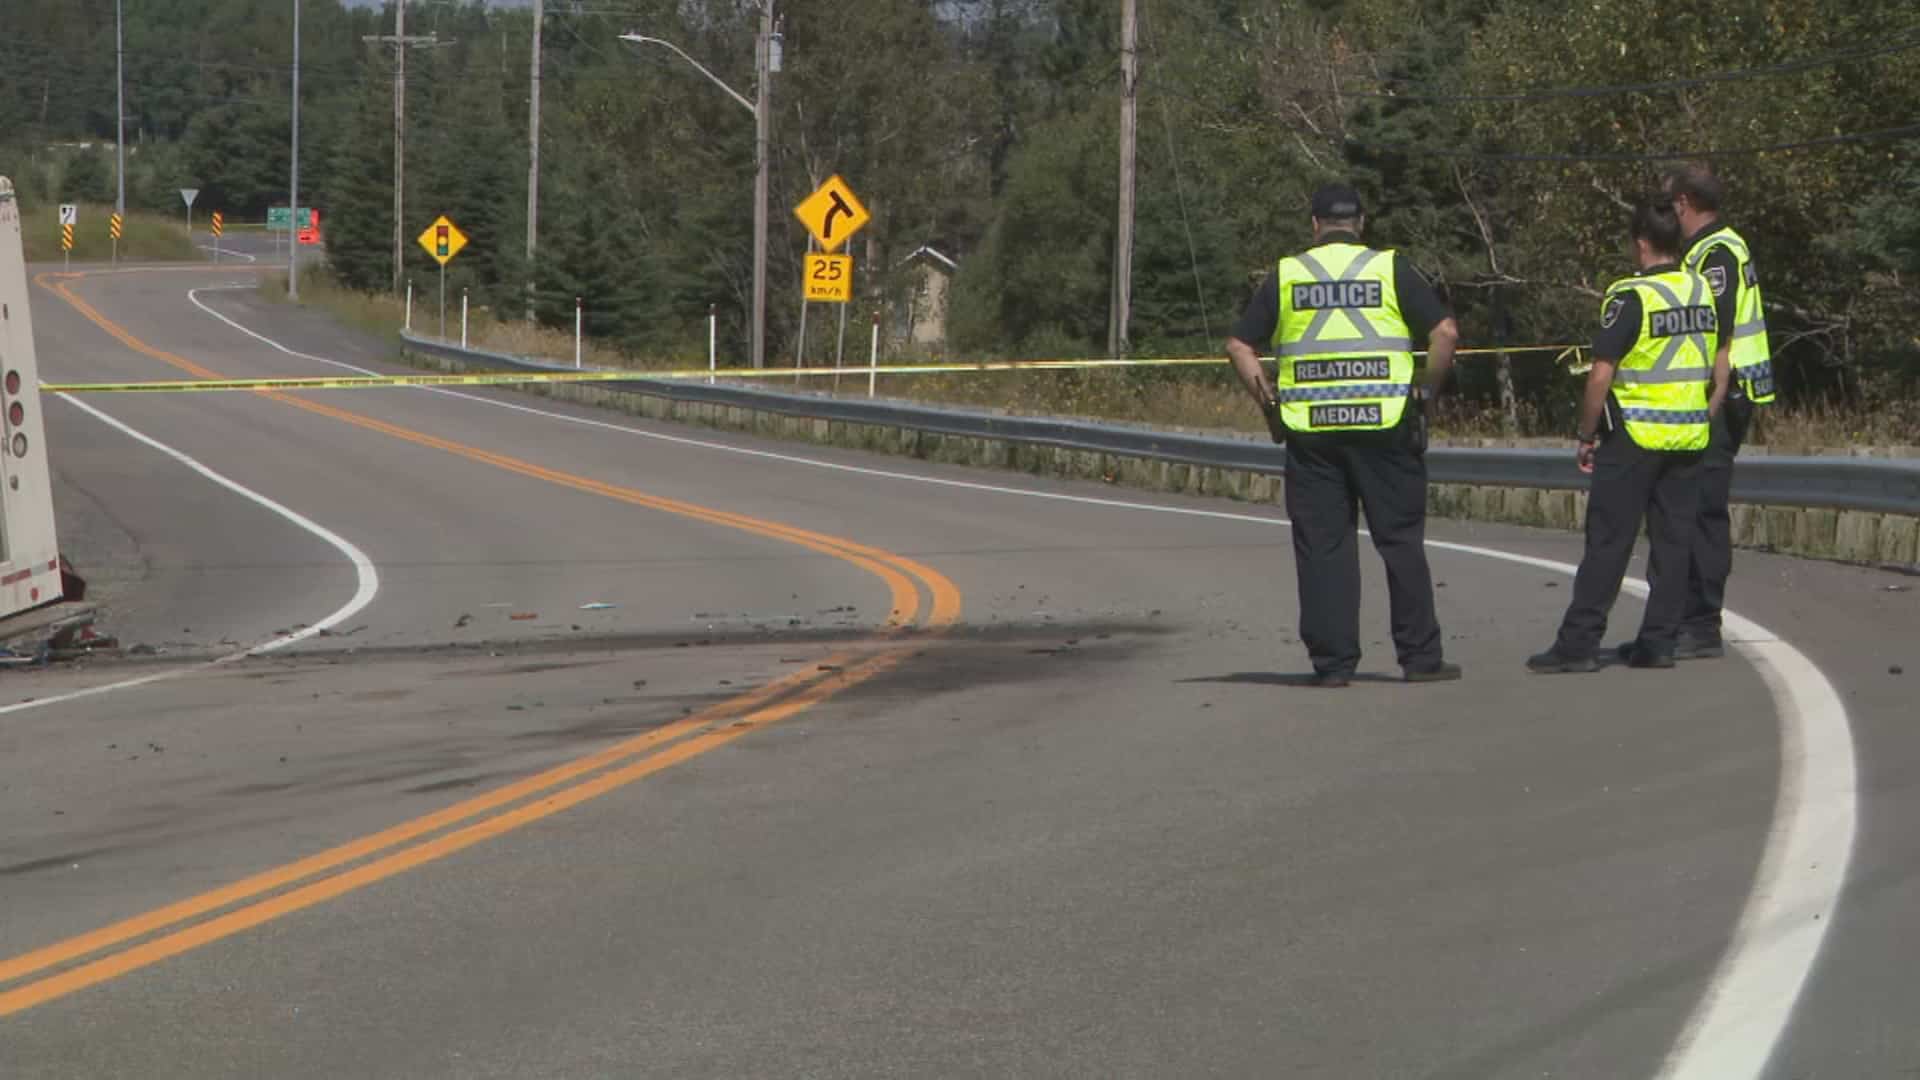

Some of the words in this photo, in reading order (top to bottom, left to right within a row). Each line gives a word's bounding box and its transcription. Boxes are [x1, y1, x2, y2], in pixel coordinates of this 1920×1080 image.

[813, 259, 842, 281] 25
[811, 286, 842, 297] km/h
[1294, 283, 1380, 308] POLICE
[1653, 308, 1714, 337] POLICE
[1297, 360, 1389, 381] RELATIONS
[1311, 407, 1379, 425] MEDIAS
